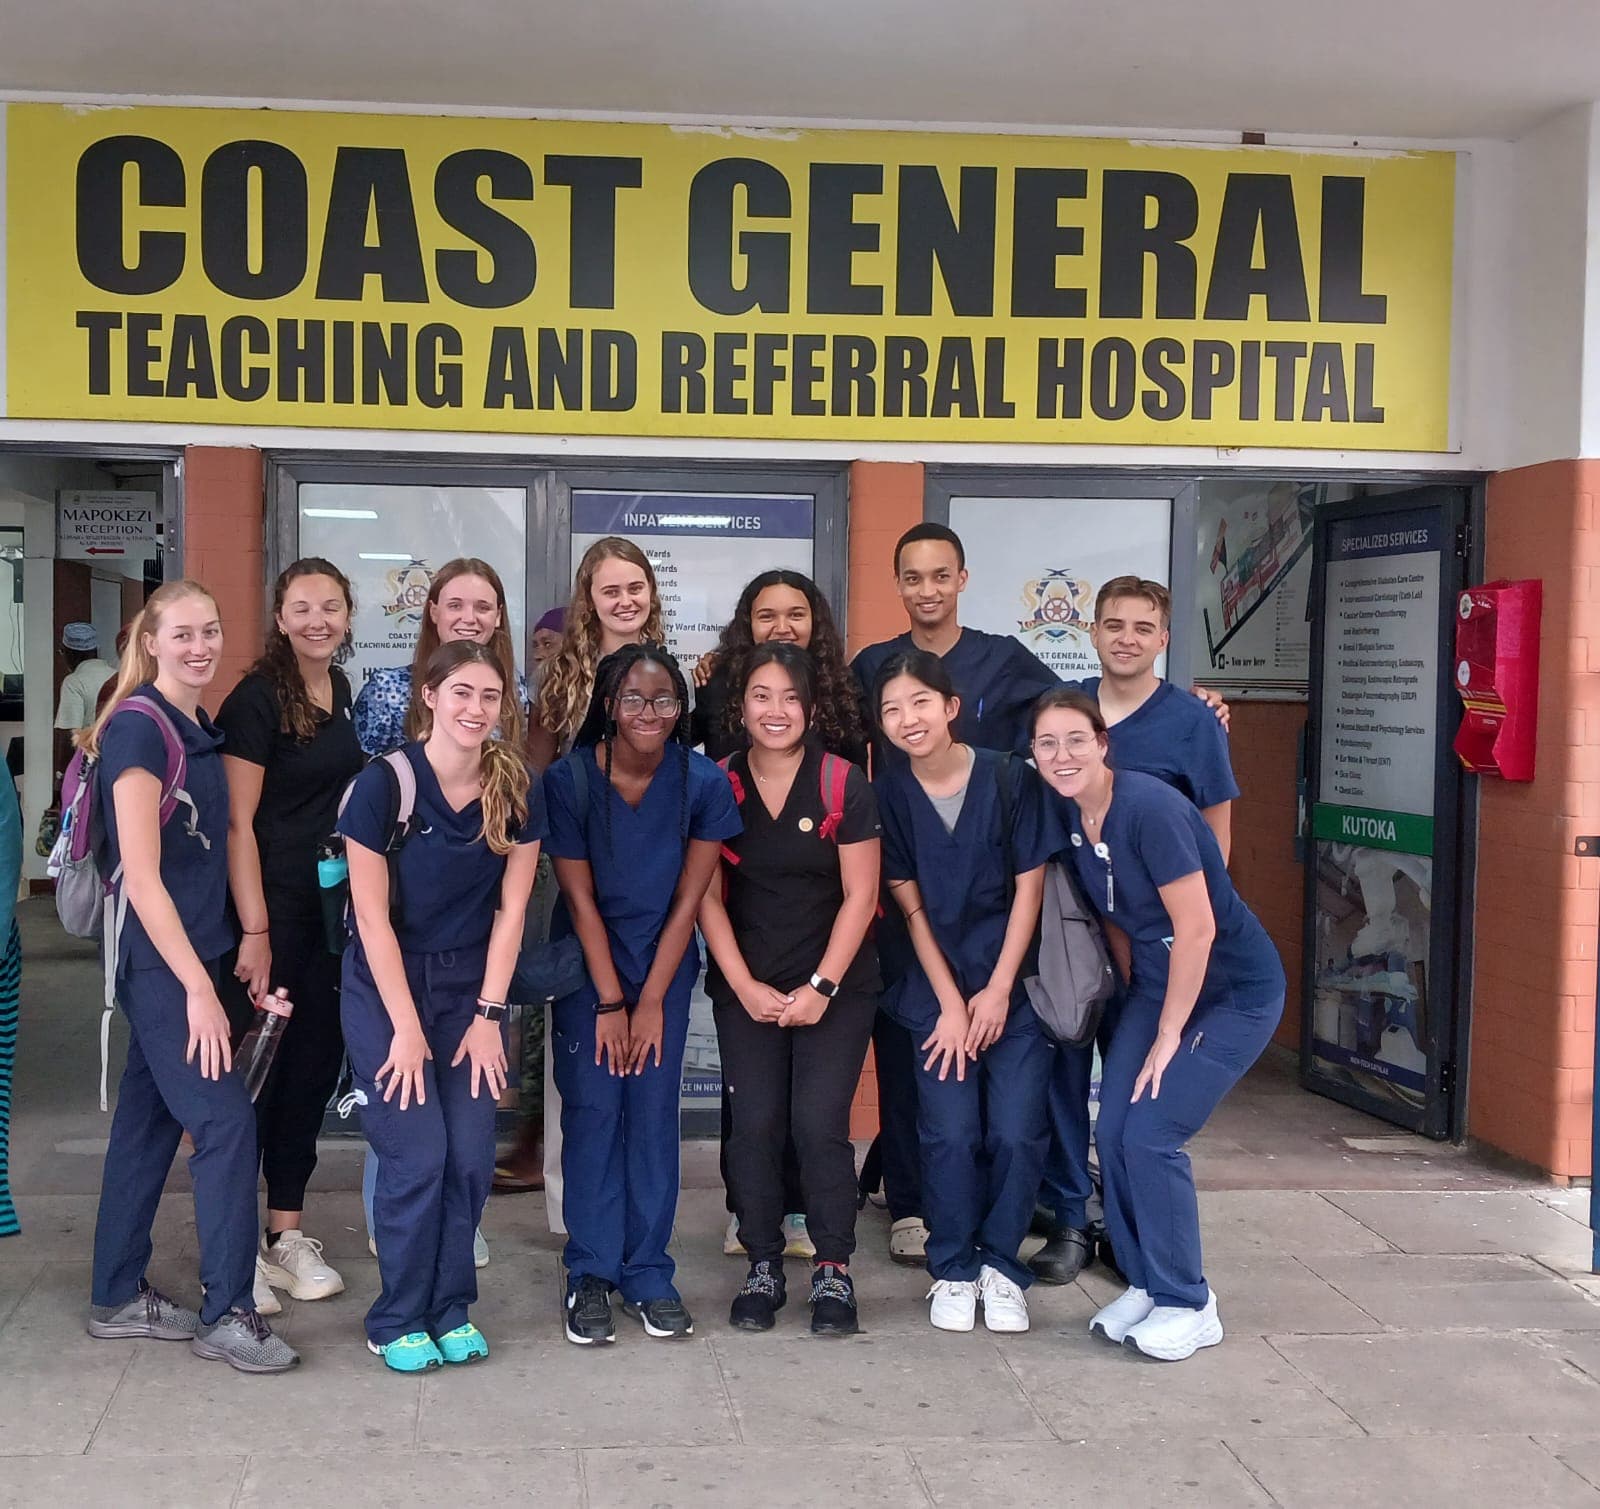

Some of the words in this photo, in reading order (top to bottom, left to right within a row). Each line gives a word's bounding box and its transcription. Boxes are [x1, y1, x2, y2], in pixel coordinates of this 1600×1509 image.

[76, 135, 642, 309] COAST
[688, 157, 1387, 324] GENERAL
[76, 311, 463, 408] TEACHING
[483, 326, 638, 412] AND
[661, 331, 1015, 418] REFERRAL
[1036, 337, 1384, 423] HOSPITAL
[63, 509, 152, 522] MAPOKEZI
[75, 524, 143, 534] RECEPTION
[1342, 534, 1388, 552] SPECIALIZED
[1389, 529, 1429, 546] SERVICES
[645, 549, 671, 558] Wards
[653, 565, 678, 573] Wards
[675, 623, 696, 632] Ward
[388, 632, 411, 640] COAST
[1051, 652, 1088, 660] GENERAL
[1342, 815, 1396, 841] KUTOKA
